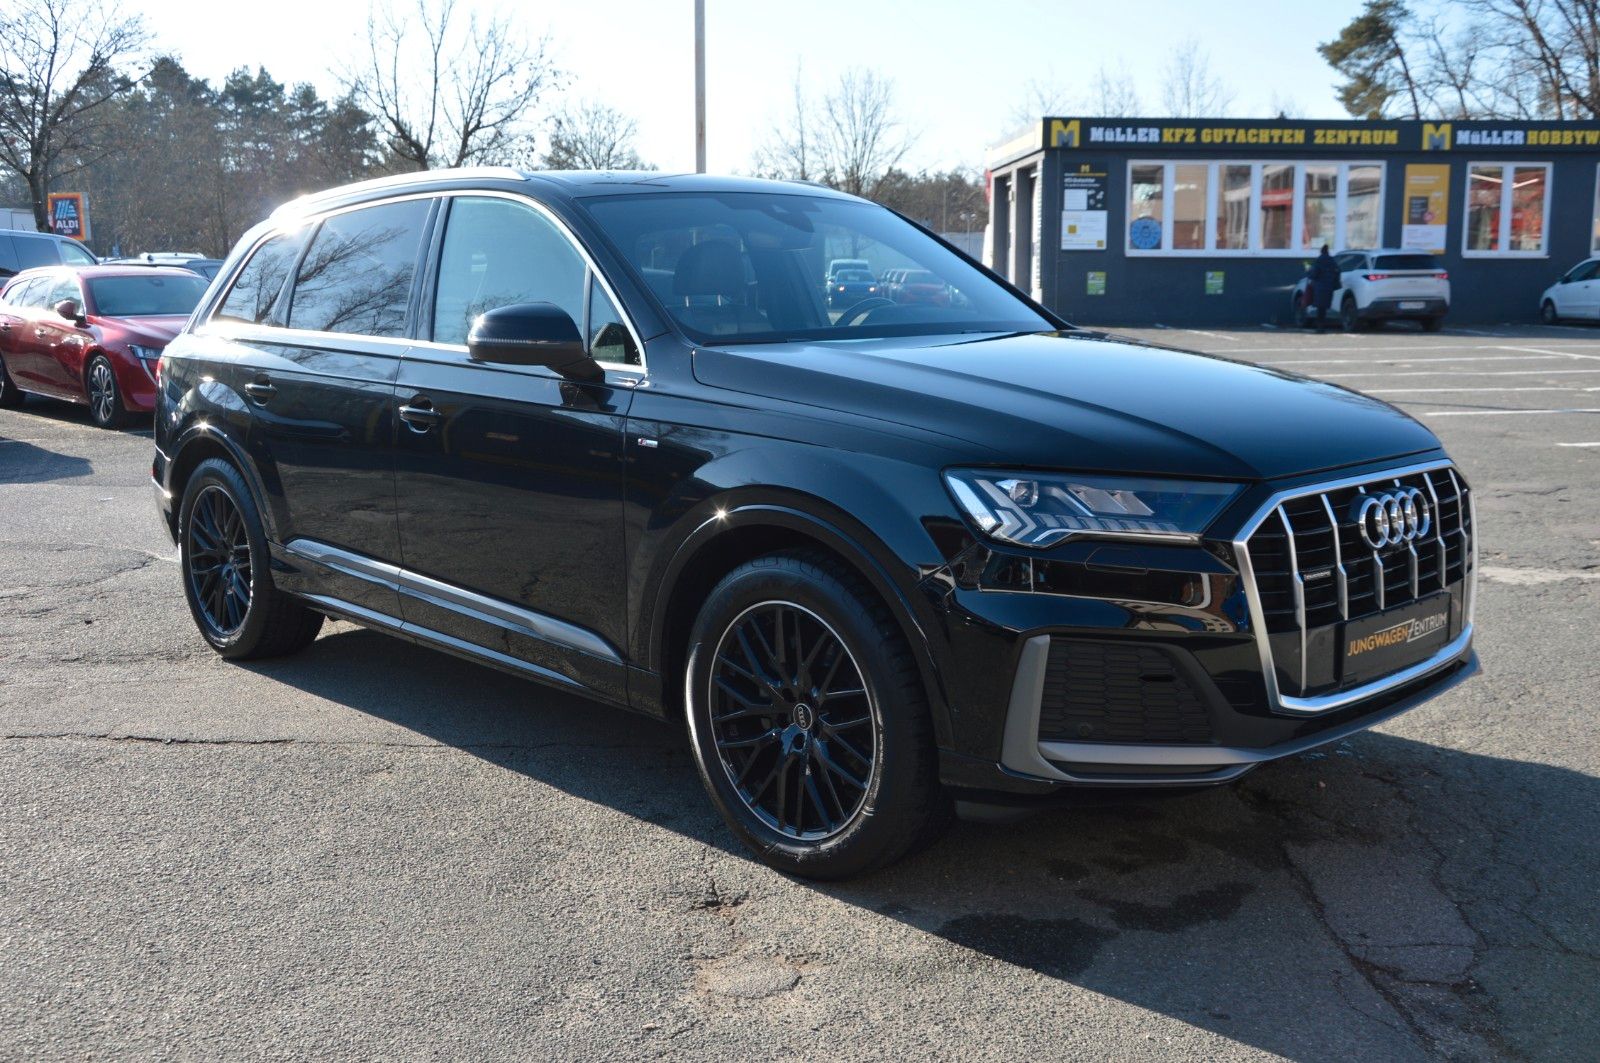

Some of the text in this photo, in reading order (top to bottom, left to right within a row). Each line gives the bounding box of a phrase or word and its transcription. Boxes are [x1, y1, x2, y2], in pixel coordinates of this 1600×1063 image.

[1162, 128, 1196, 143] KFZ
[1201, 128, 1305, 144] GUTACHTEN
[1314, 129, 1398, 144] ZENTRUM
[56, 220, 78, 229] ALDI
